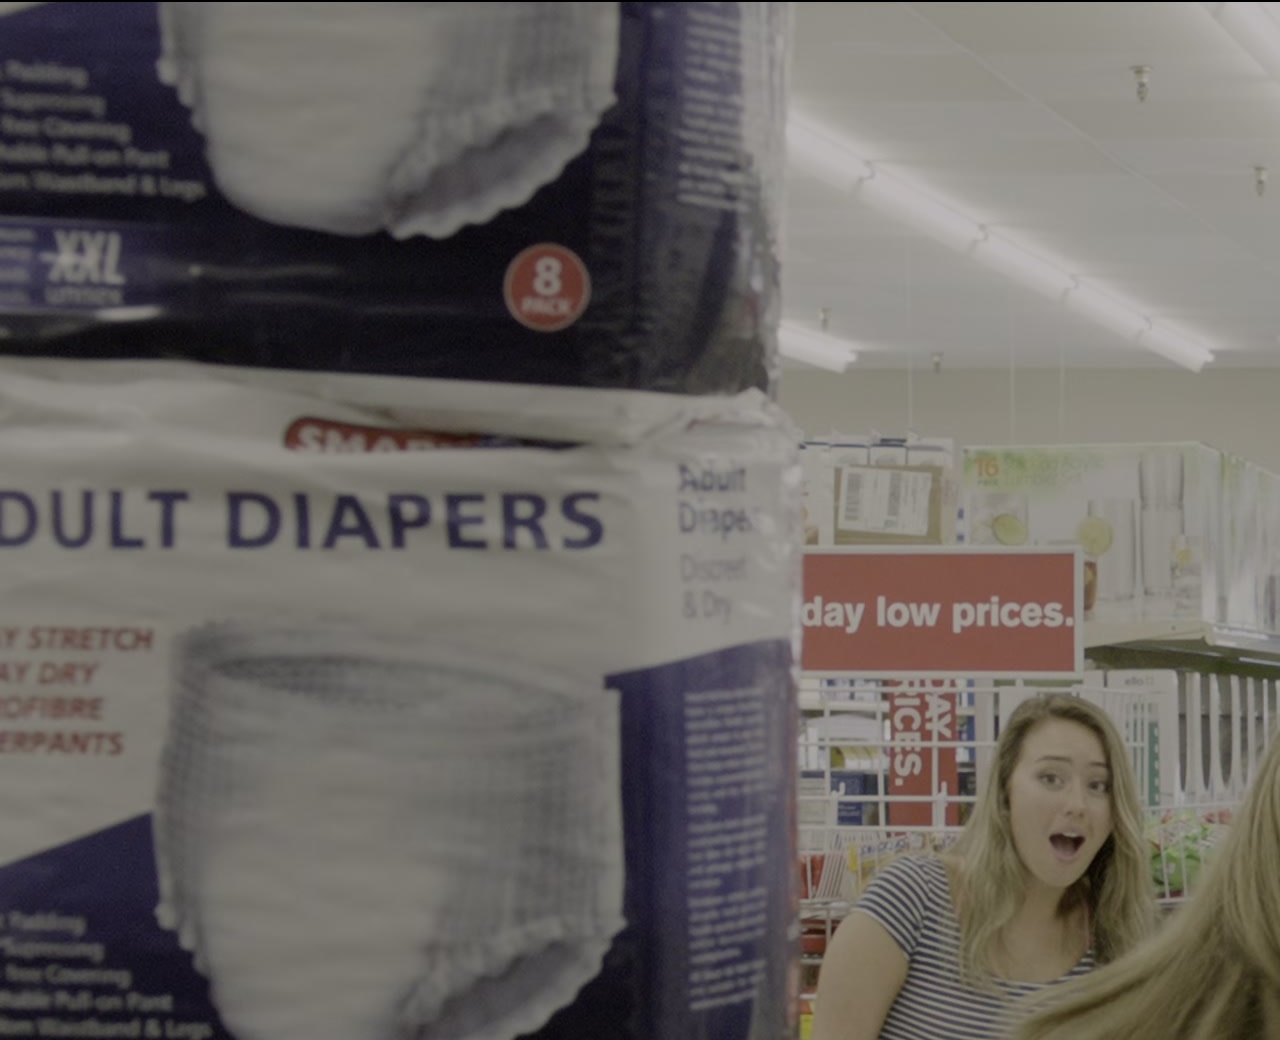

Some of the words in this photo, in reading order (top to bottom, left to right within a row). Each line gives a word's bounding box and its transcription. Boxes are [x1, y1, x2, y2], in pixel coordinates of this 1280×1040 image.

[49, 230, 126, 285] XXL
[533, 257, 563, 296] 8
[227, 490, 604, 551] DIAPERS
[876, 596, 940, 627] low
[953, 596, 1074, 634] prices.
[28, 626, 155, 651] STRETCH
[38, 661, 100, 686] DRY
[0, 729, 124, 757] ERPANTS
